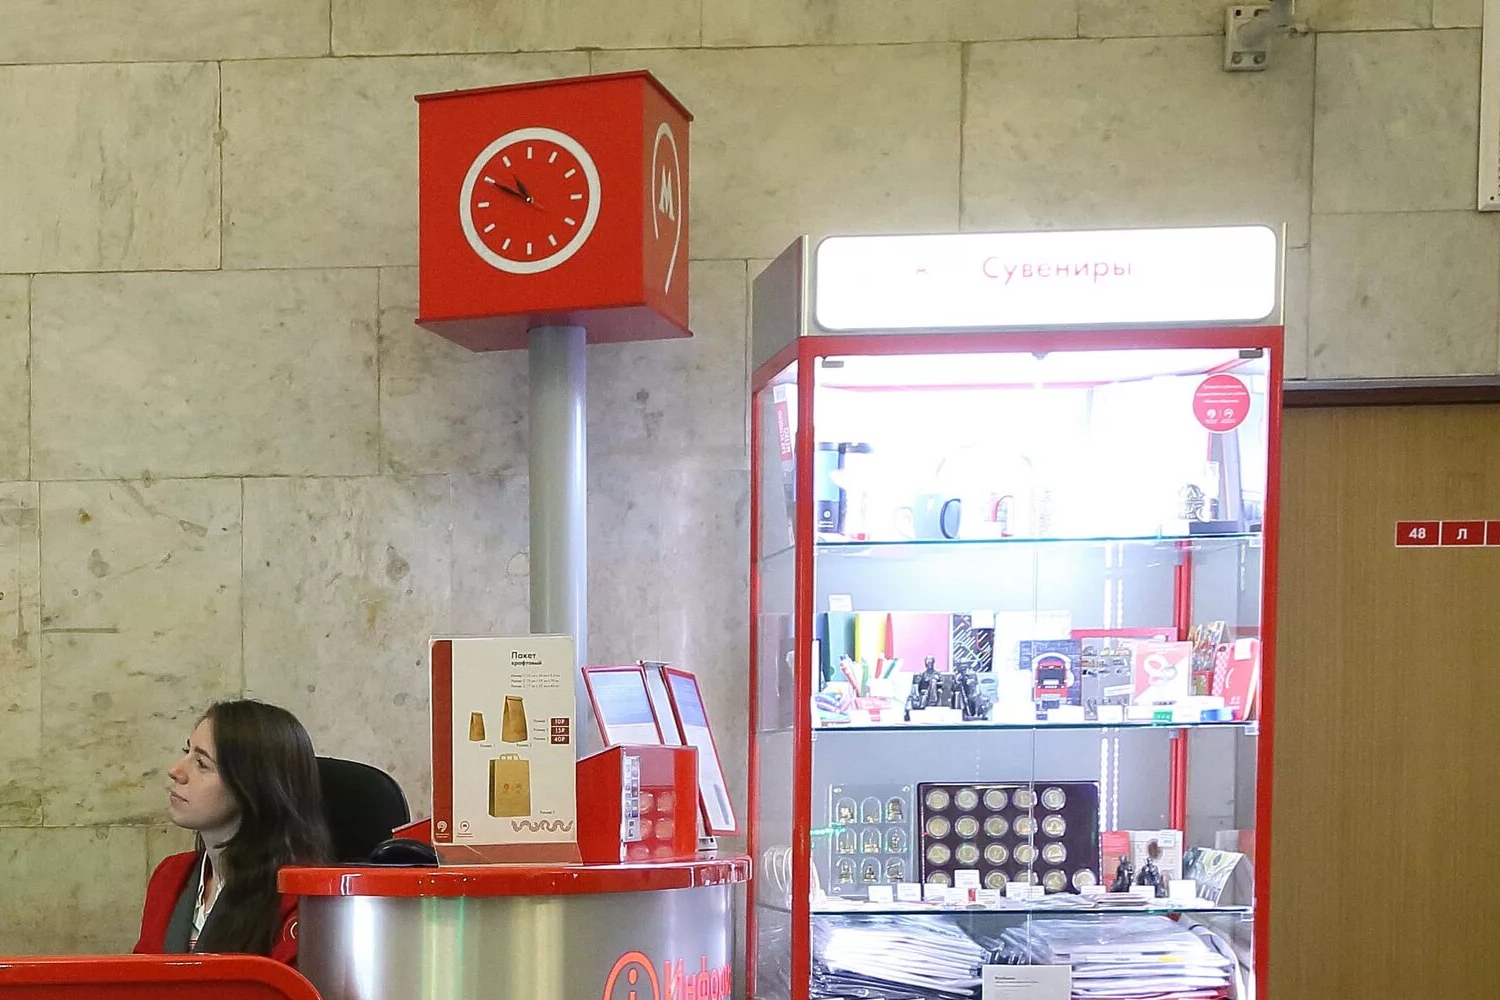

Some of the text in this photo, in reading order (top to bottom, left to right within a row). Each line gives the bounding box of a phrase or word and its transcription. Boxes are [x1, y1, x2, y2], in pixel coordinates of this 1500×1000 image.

[982, 256, 1132, 285] Сувениры
[1408, 527, 1427, 540] 48
[511, 651, 536, 659] Пакет
